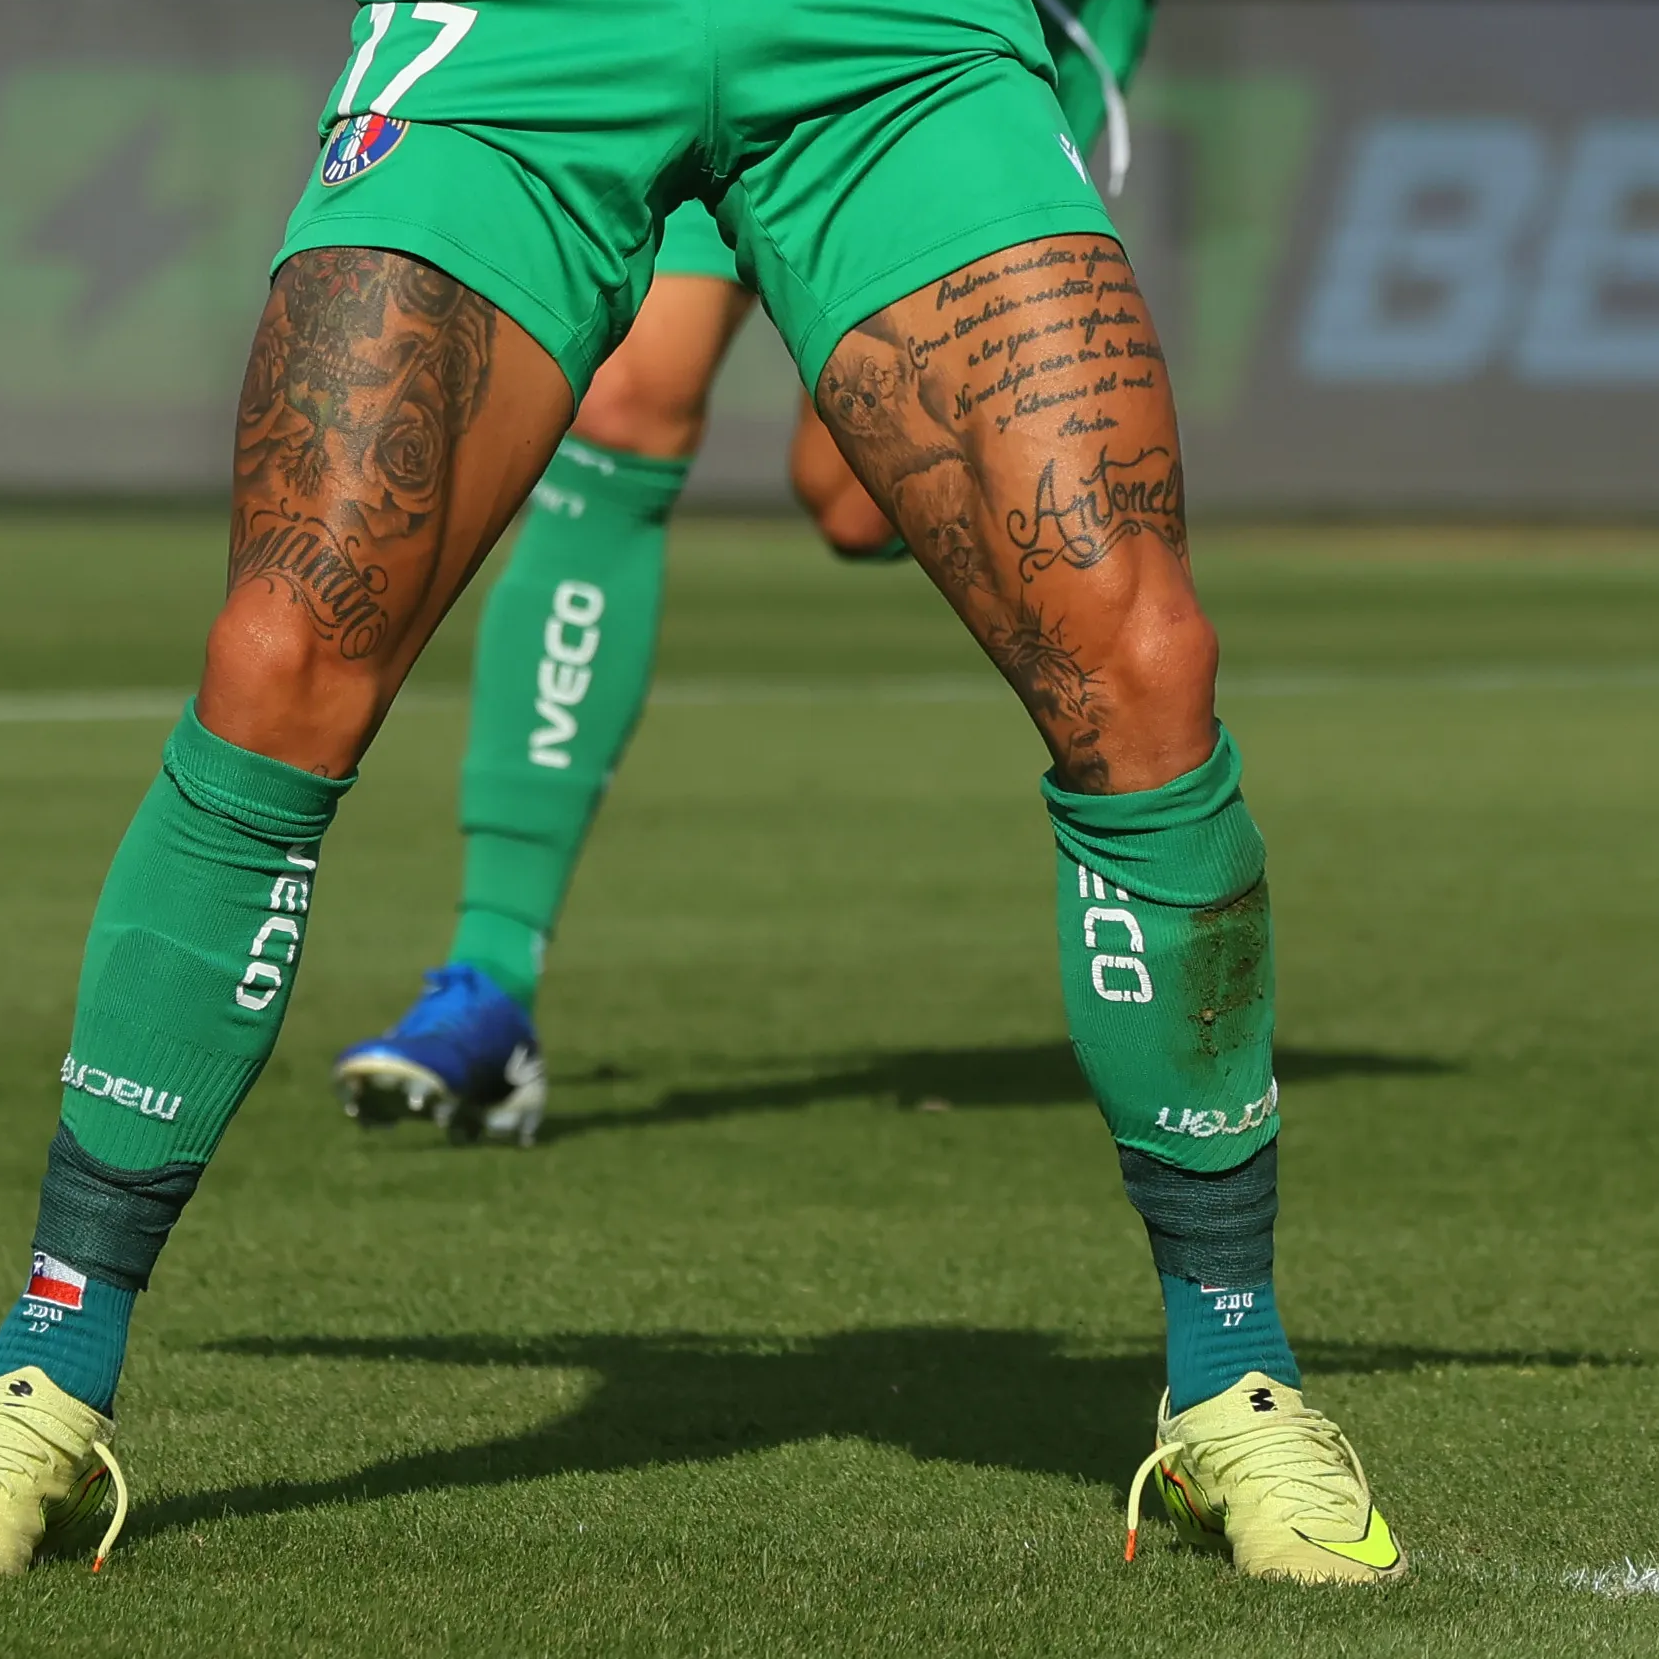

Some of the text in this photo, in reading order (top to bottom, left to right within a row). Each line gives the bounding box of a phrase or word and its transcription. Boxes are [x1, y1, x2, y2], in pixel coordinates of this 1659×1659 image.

[337, 1, 478, 116] 17
[528, 579, 605, 770] IVECO
[1213, 1291, 1254, 1311] EDU
[28, 1321, 50, 1333] 17
[1222, 1311, 1245, 1327] 17
